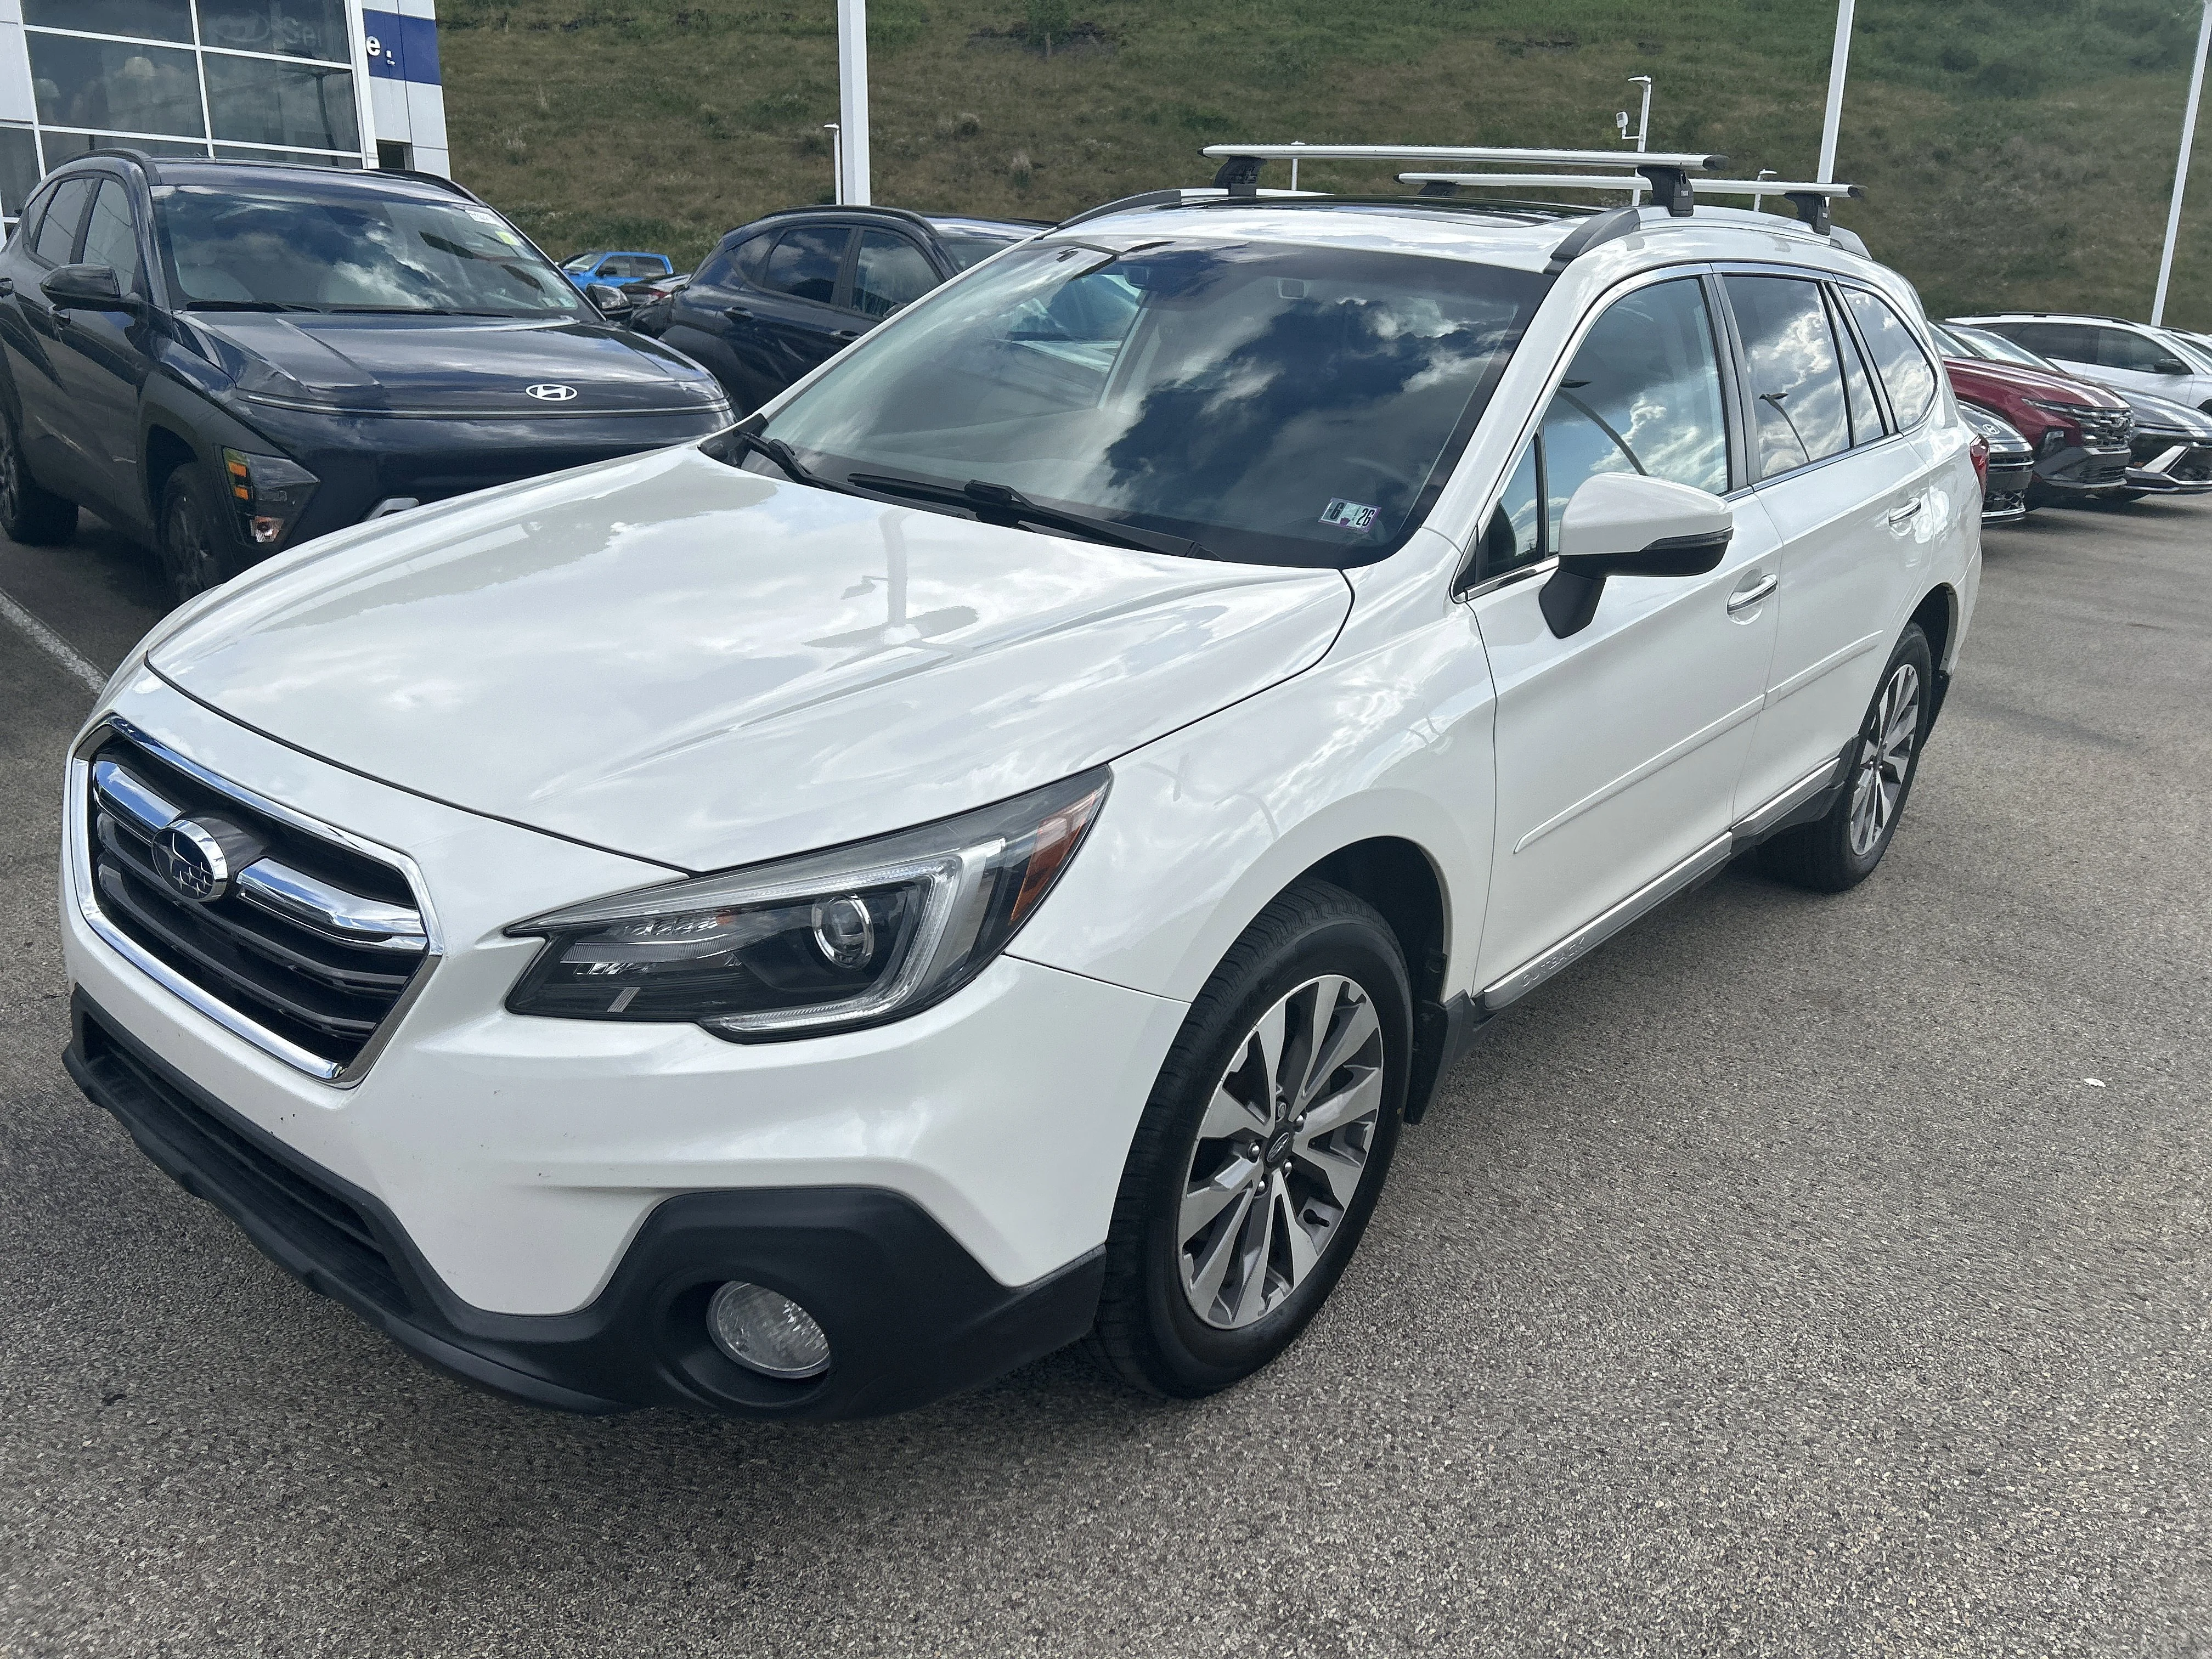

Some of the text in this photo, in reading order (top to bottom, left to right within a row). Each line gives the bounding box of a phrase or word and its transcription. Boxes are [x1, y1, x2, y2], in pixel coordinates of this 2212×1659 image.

[1329, 502, 1345, 520] 6
[1355, 507, 1375, 527] 26
[1521, 934, 1587, 988] OUTBACK
